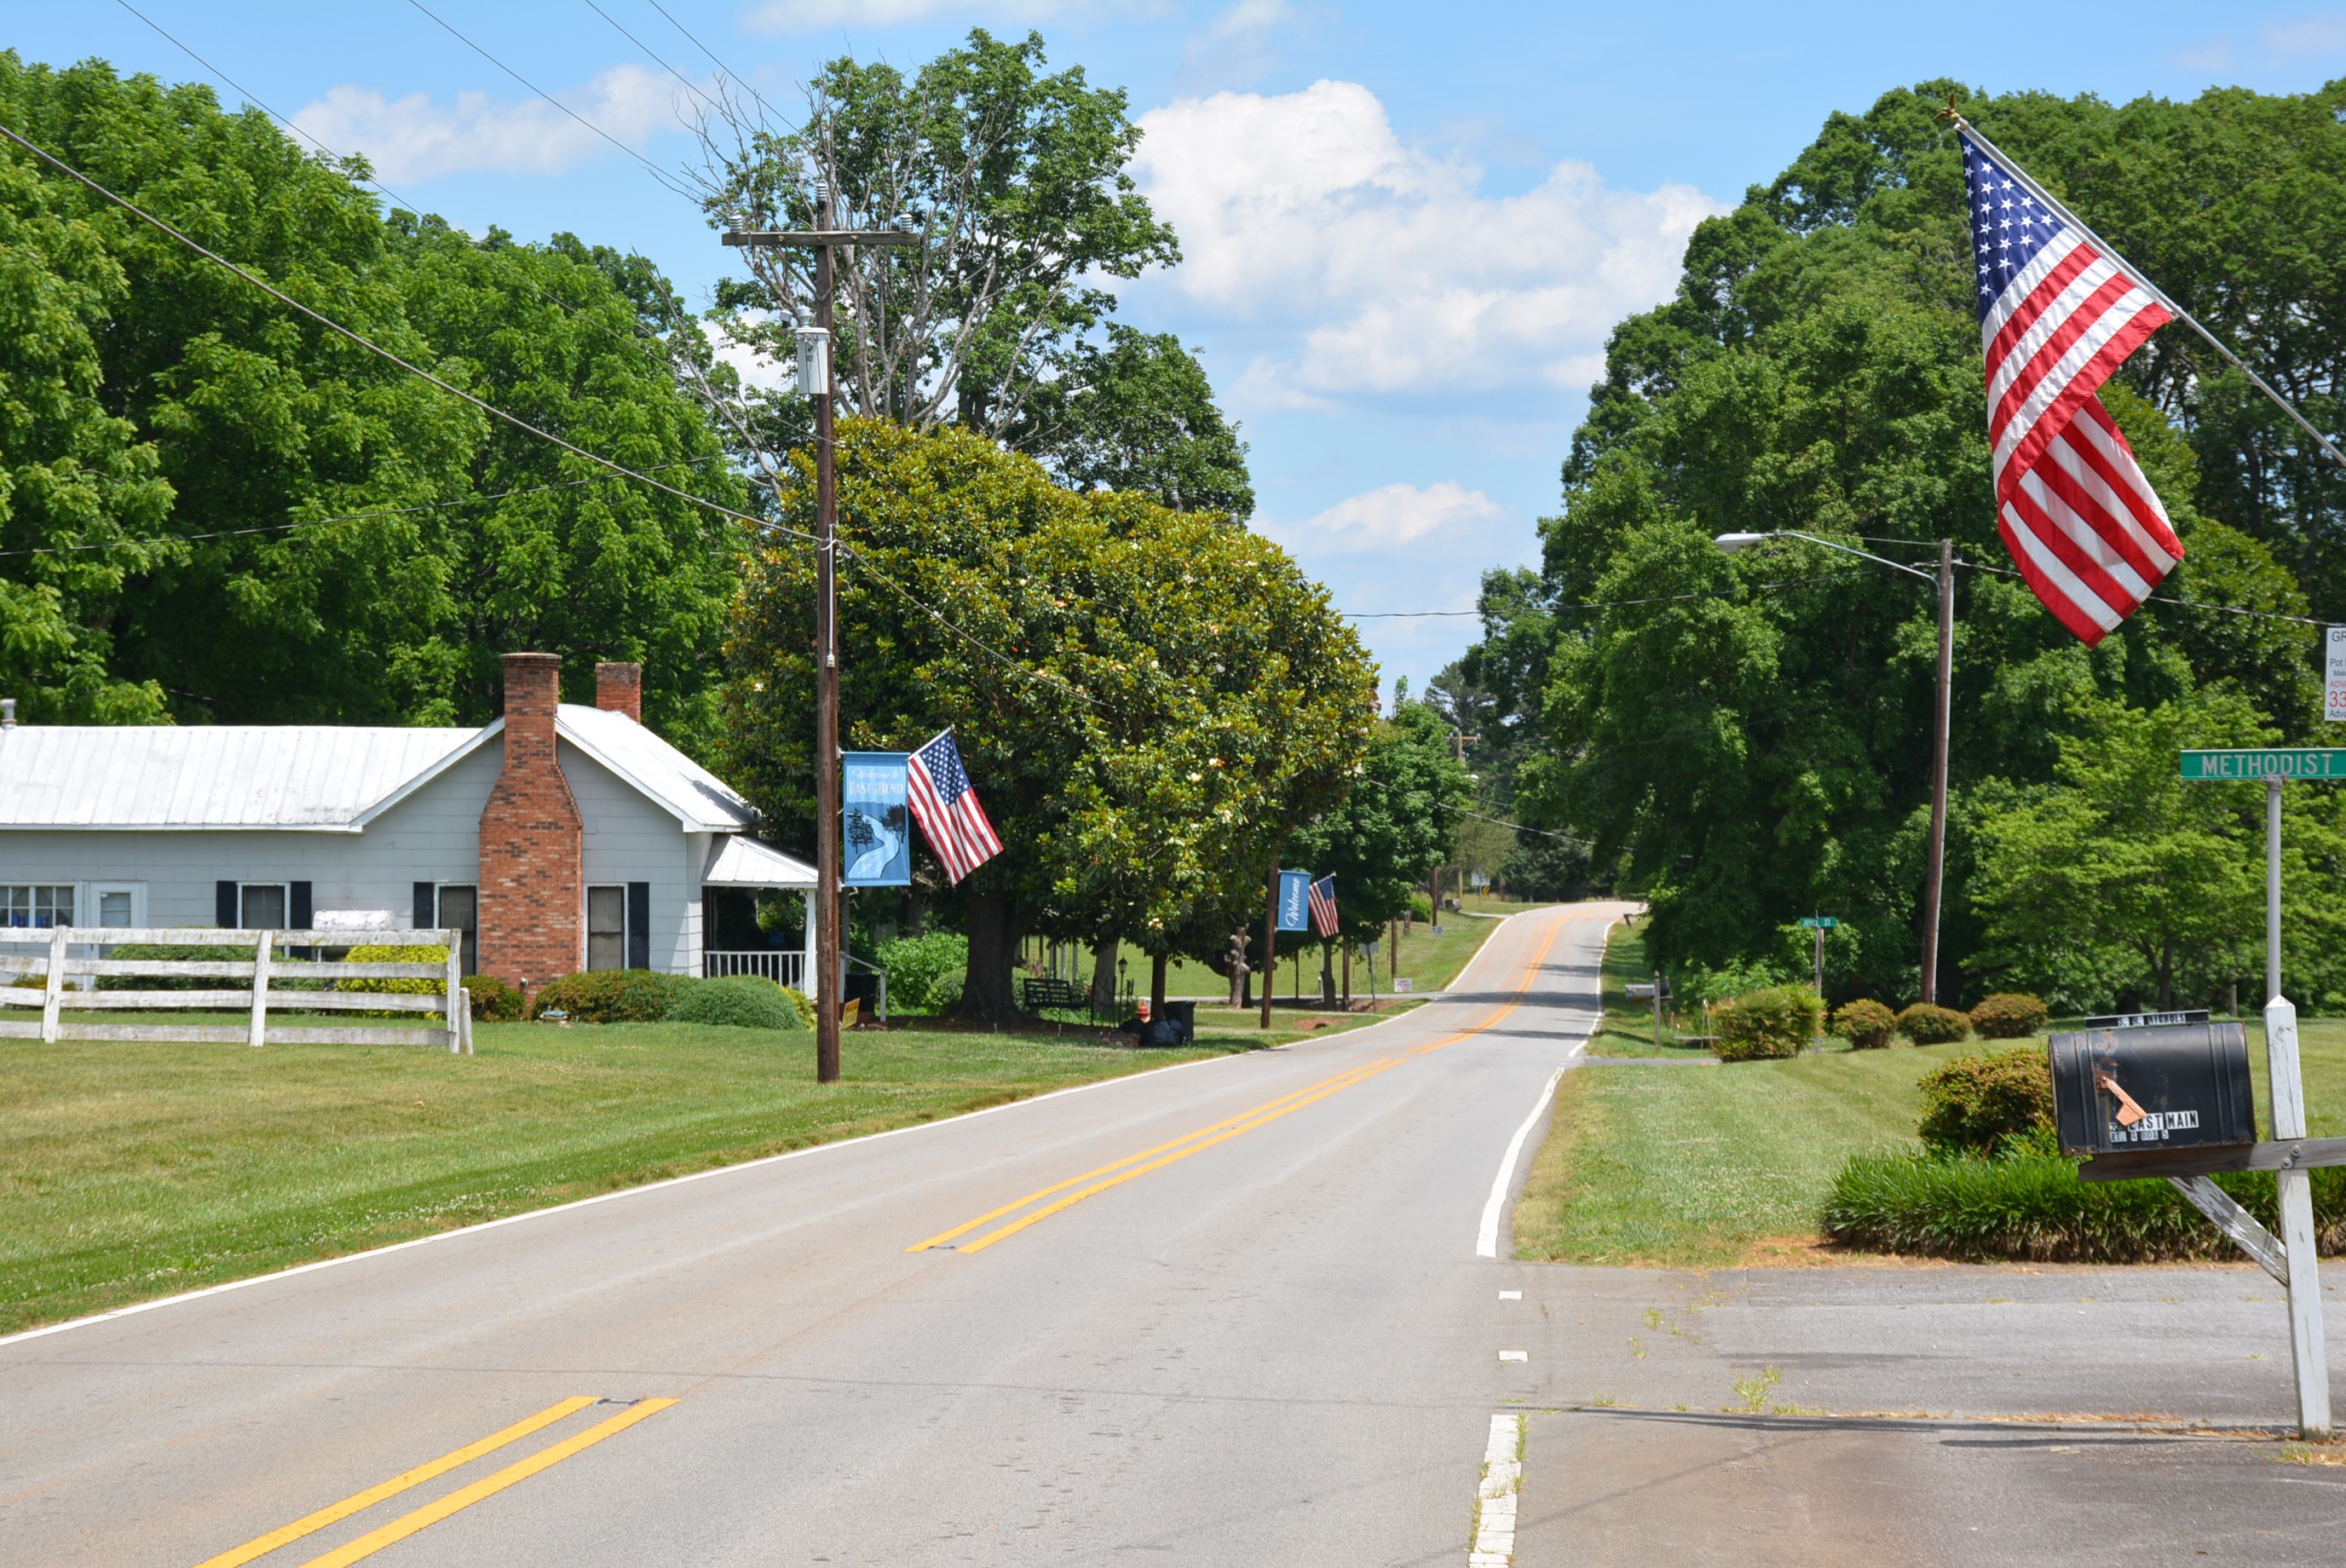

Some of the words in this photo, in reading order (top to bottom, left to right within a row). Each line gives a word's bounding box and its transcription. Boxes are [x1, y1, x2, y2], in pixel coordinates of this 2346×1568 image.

[852, 768, 890, 779] Welcome
[2202, 753, 2333, 775] METHODIST
[1285, 877, 1300, 927] Welcome
[2167, 1111, 2197, 1128] MAIN
